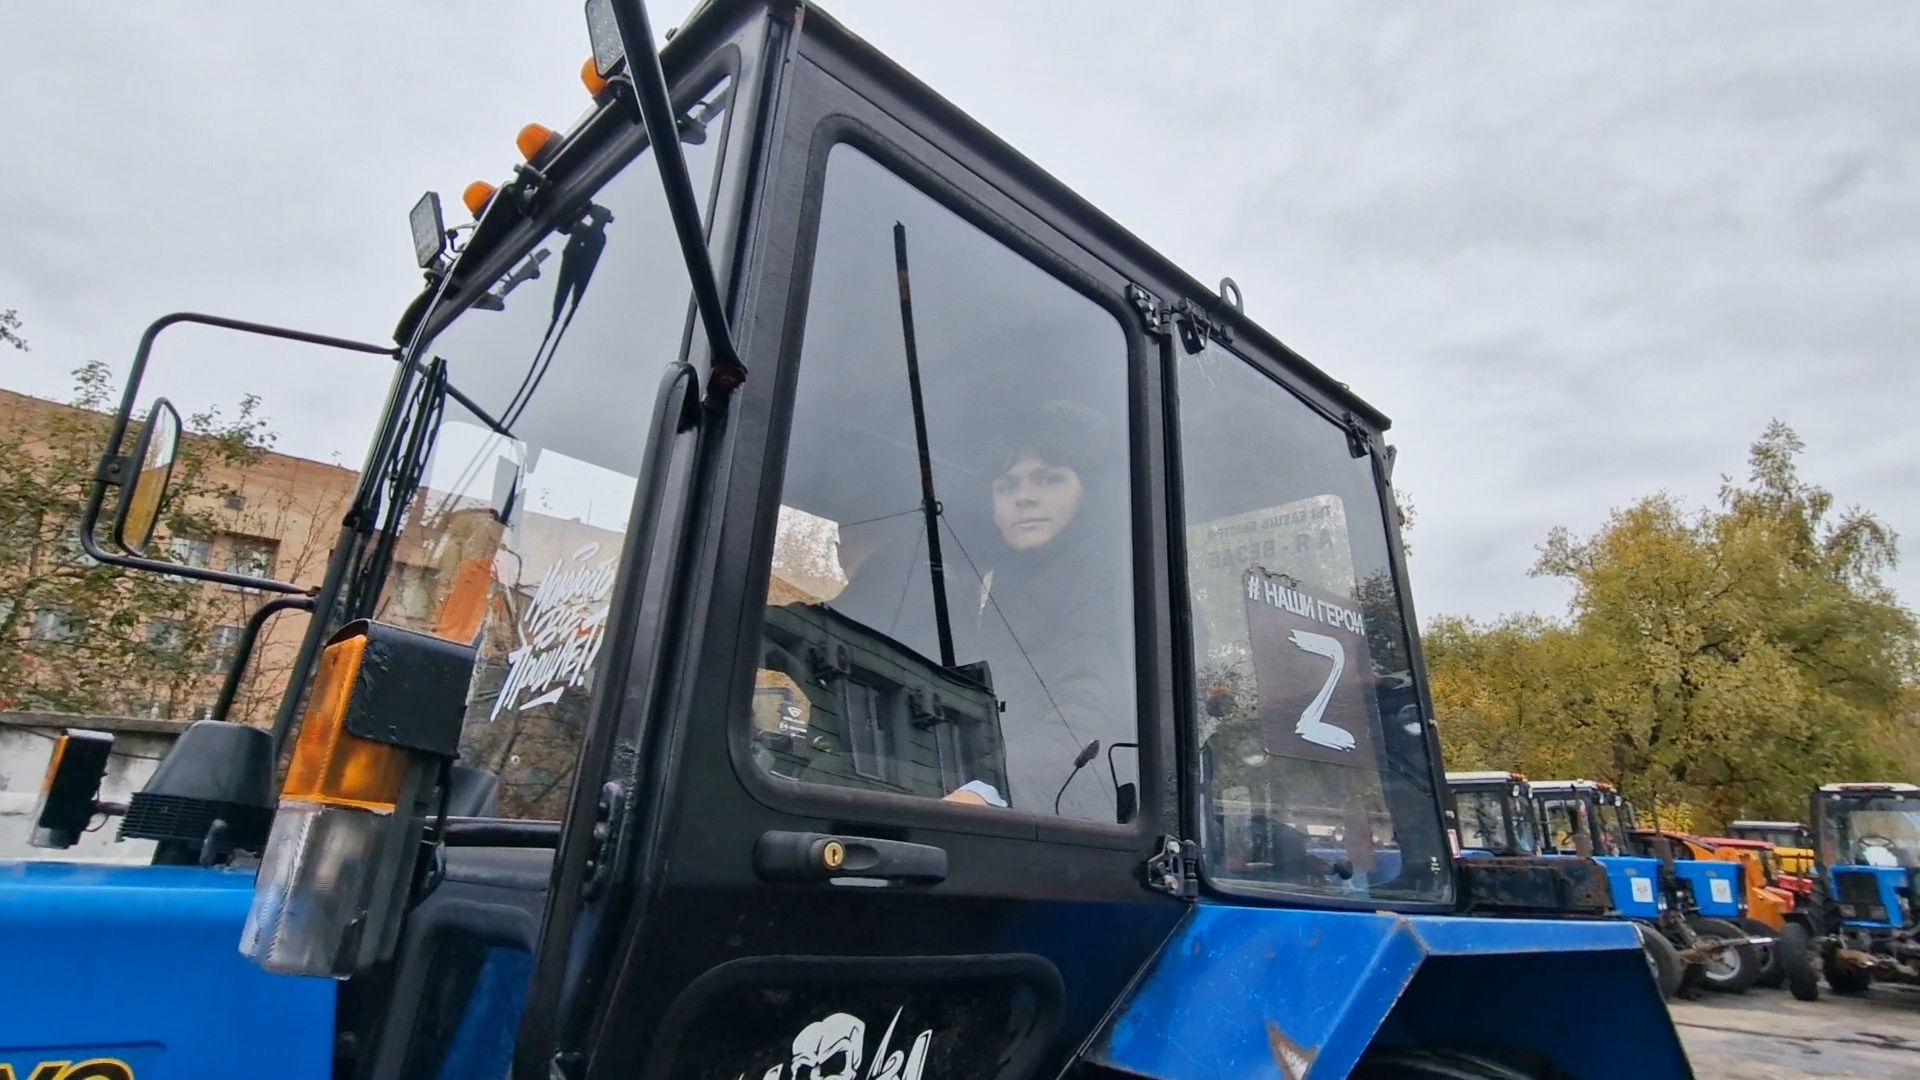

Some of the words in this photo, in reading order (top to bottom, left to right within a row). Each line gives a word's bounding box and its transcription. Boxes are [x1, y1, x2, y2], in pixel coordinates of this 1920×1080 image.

[1264, 580, 1315, 619] НАШИ
[1317, 599, 1365, 636] ГЕРОИ
[1288, 629, 1356, 751] Z
